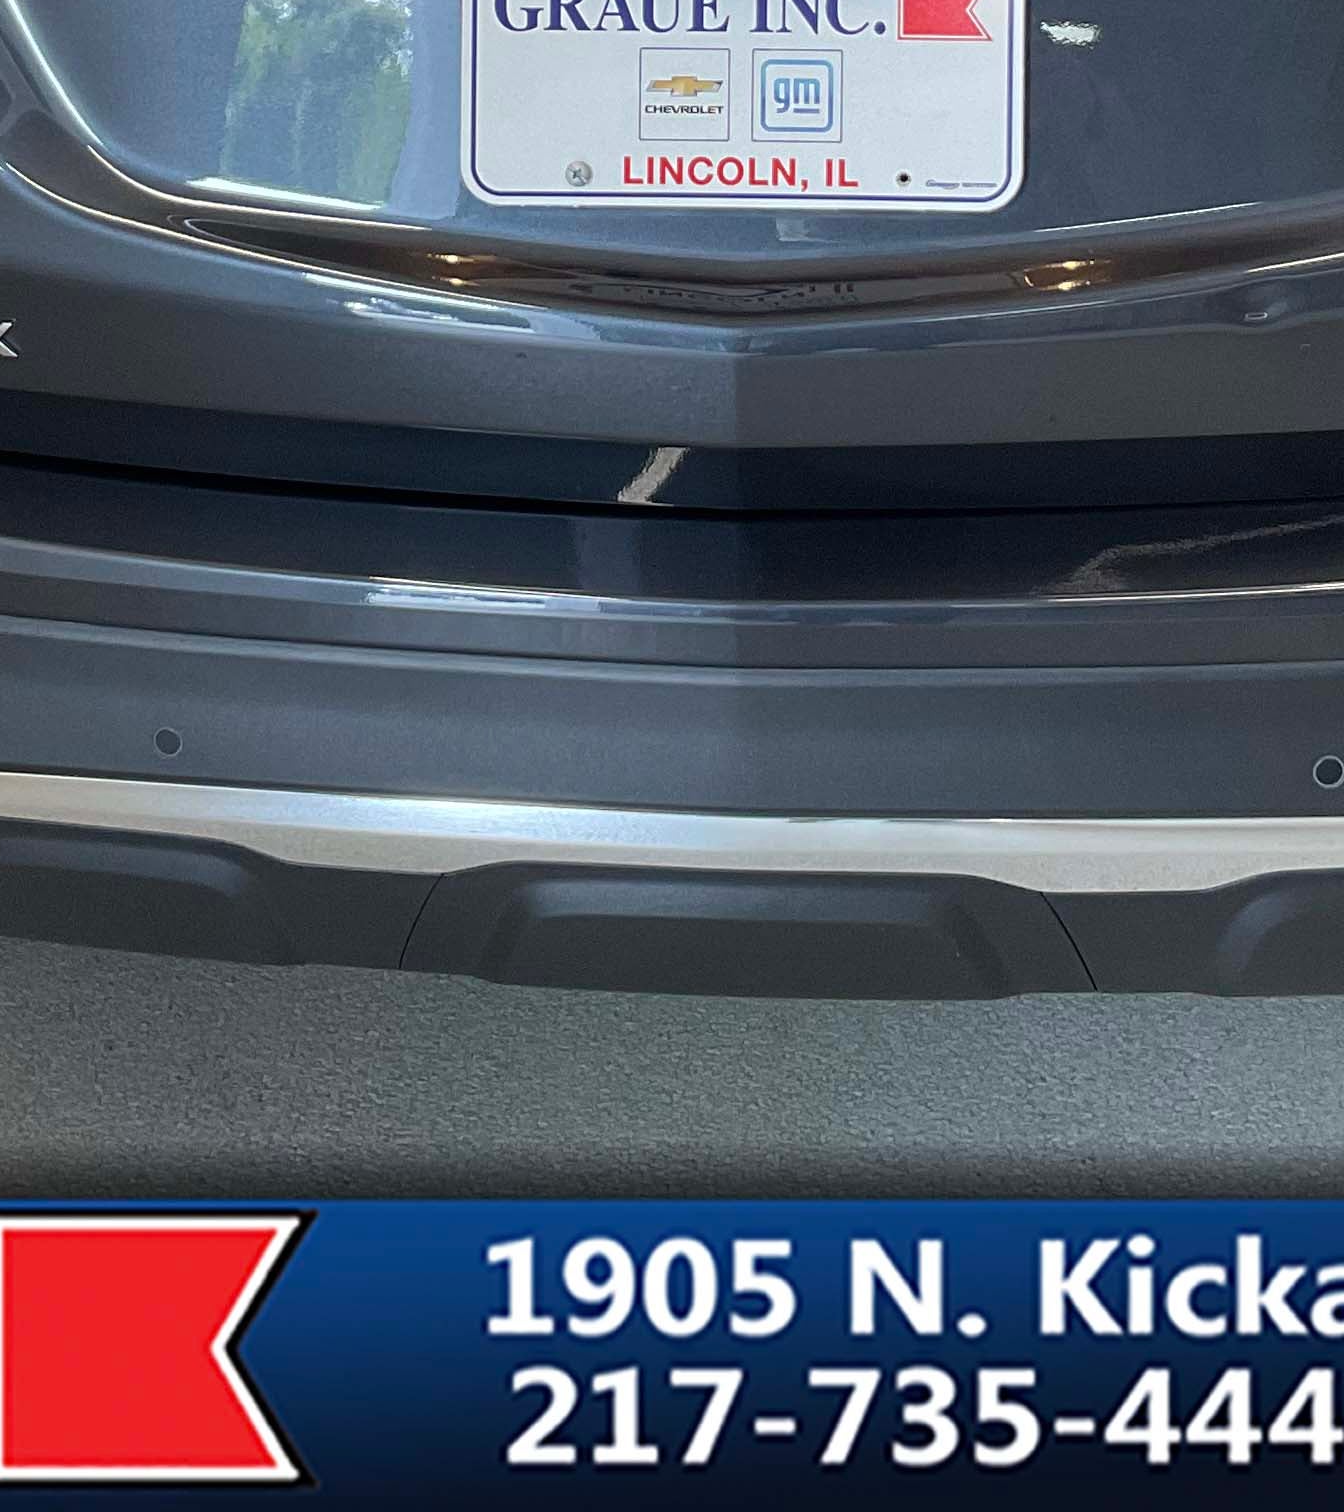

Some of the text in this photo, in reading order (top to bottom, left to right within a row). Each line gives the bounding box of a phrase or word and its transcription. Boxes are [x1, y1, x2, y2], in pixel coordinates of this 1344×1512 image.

[644, 104, 724, 115] CHEVROLET
[773, 76, 822, 114] gm
[622, 155, 859, 192] LINCOLN, IL
